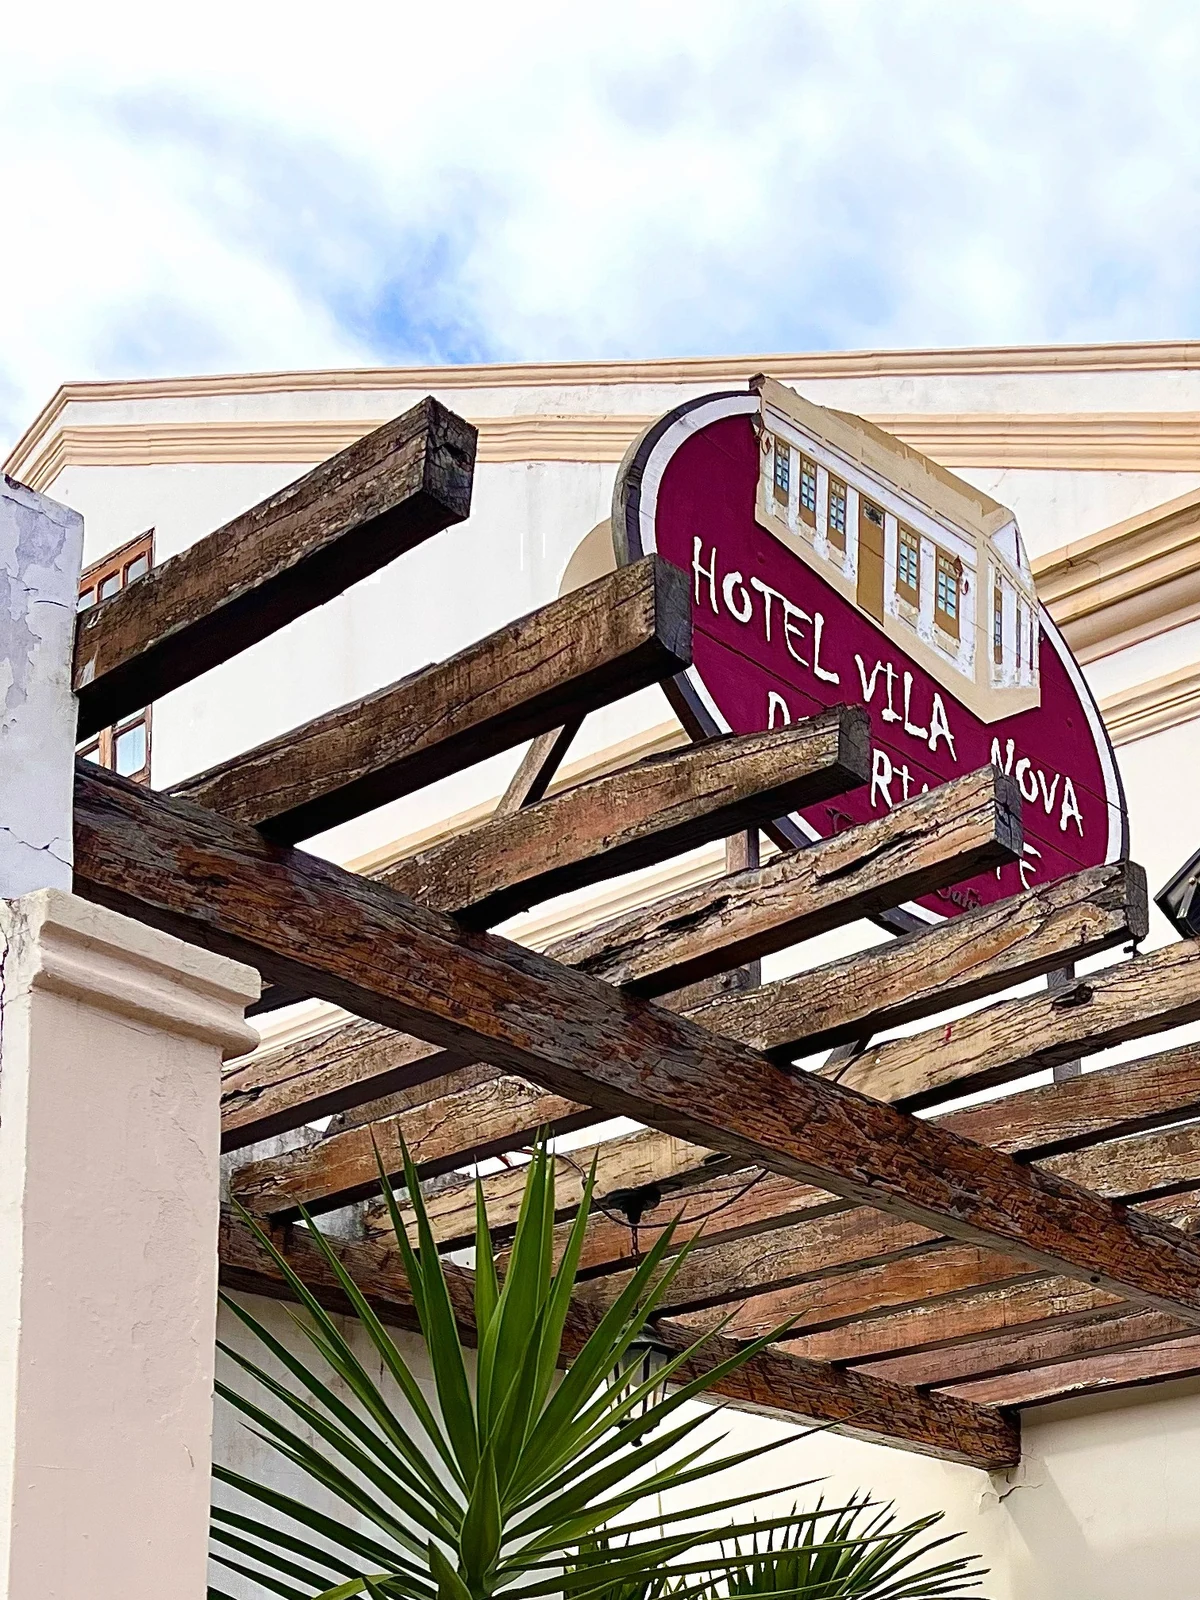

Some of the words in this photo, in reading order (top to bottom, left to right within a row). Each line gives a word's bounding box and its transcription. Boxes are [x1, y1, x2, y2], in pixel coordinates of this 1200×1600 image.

[691, 535, 840, 686] HOTEL
[854, 653, 958, 763] VILA
[990, 736, 1085, 838] NOVA
